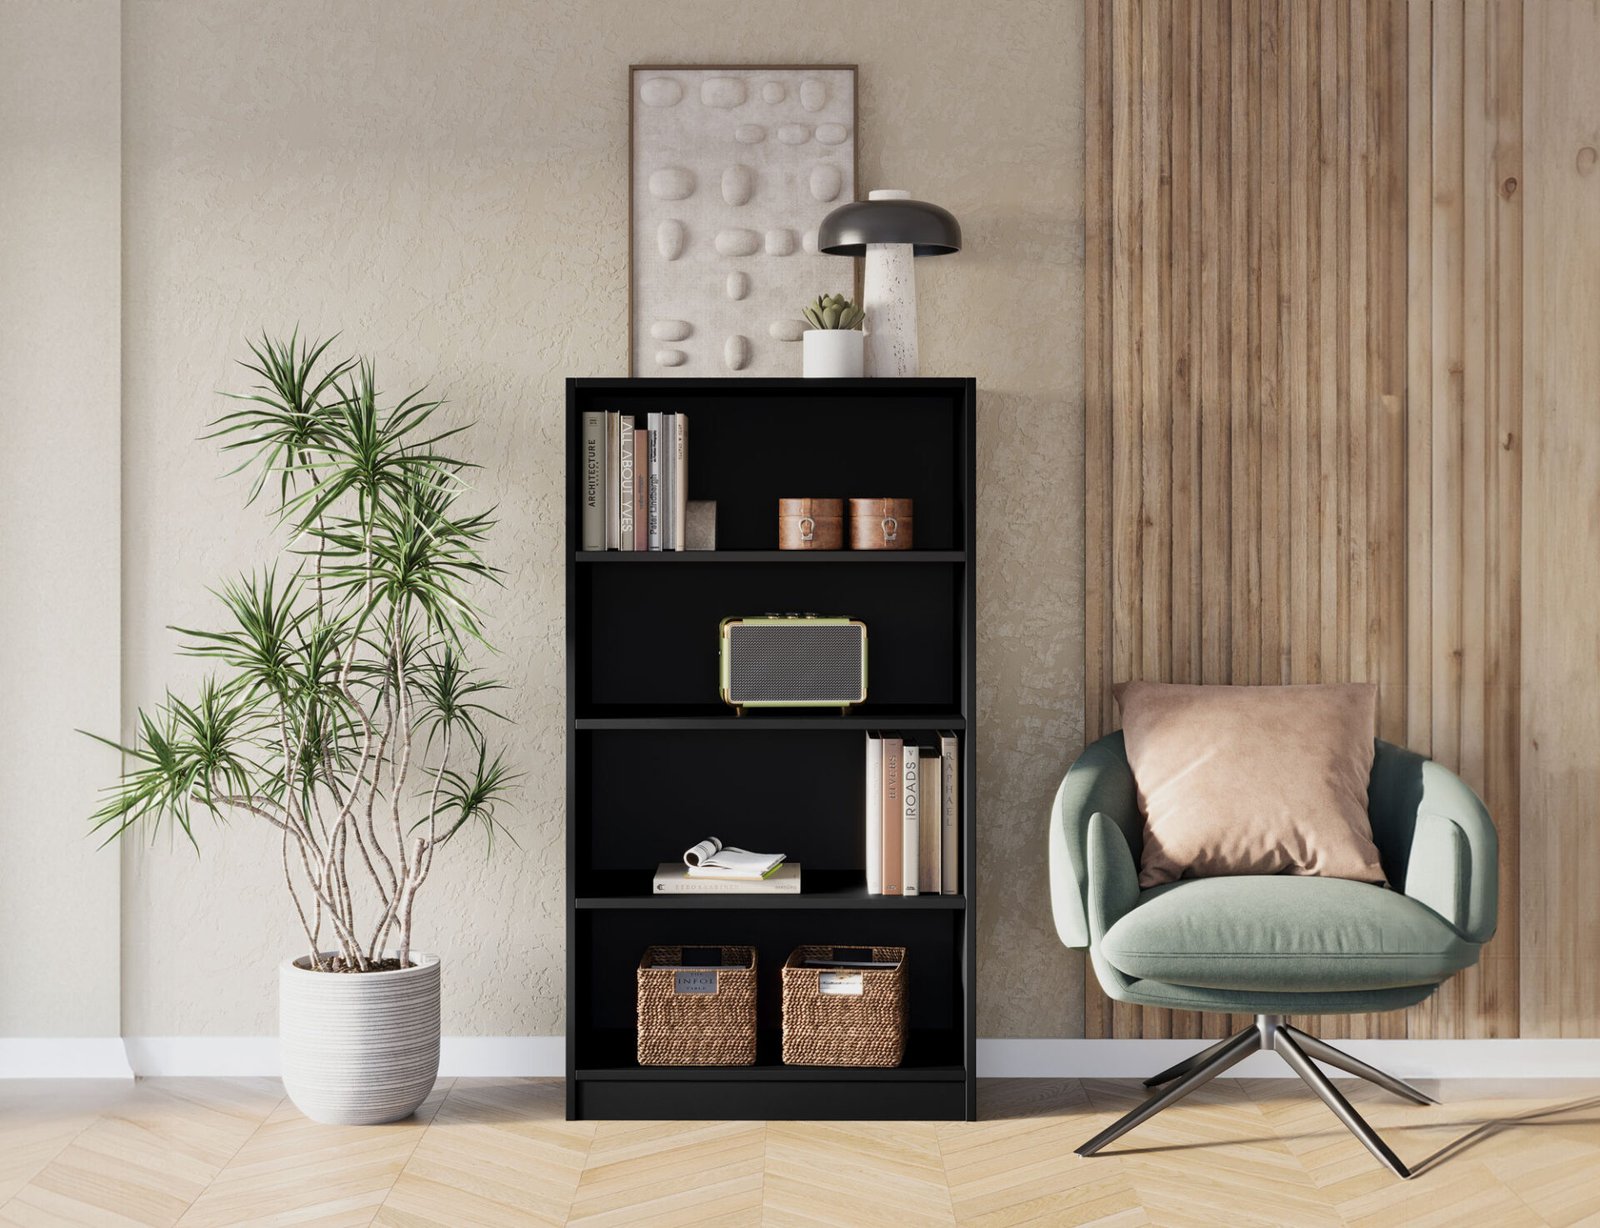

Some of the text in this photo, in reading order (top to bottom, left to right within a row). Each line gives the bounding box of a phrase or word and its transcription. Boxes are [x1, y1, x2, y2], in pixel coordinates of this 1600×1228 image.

[588, 439, 596, 507] ARCHITECTURE
[622, 422, 633, 532] ALL ABOUT YVES
[649, 514, 657, 535] Peter
[888, 755, 896, 800] RIVERS
[905, 761, 916, 816] ROADS
